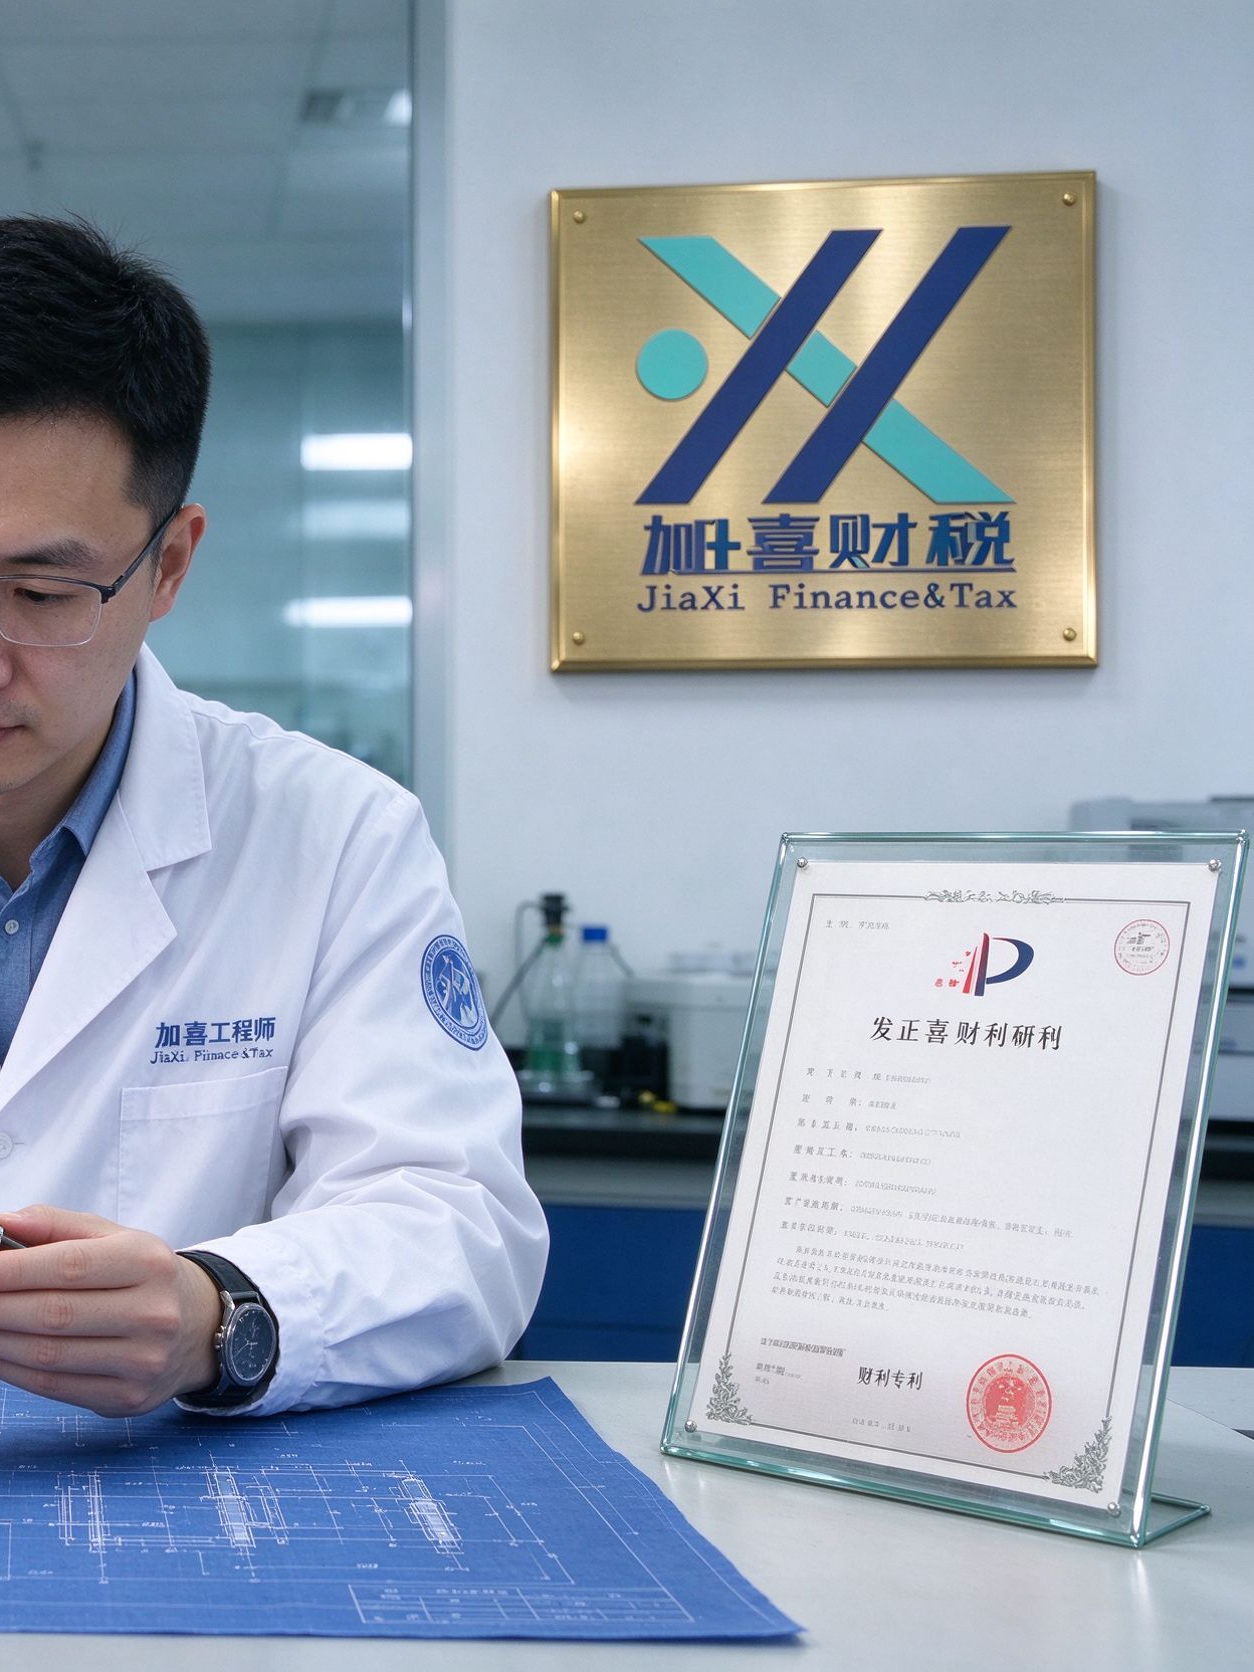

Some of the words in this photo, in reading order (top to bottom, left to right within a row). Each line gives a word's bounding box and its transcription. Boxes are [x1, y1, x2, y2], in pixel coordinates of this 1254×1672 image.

[637, 583, 745, 612] JiaXi
[769, 582, 1017, 610] Finance&Tax
[154, 1016, 276, 1048] 加喜工程师
